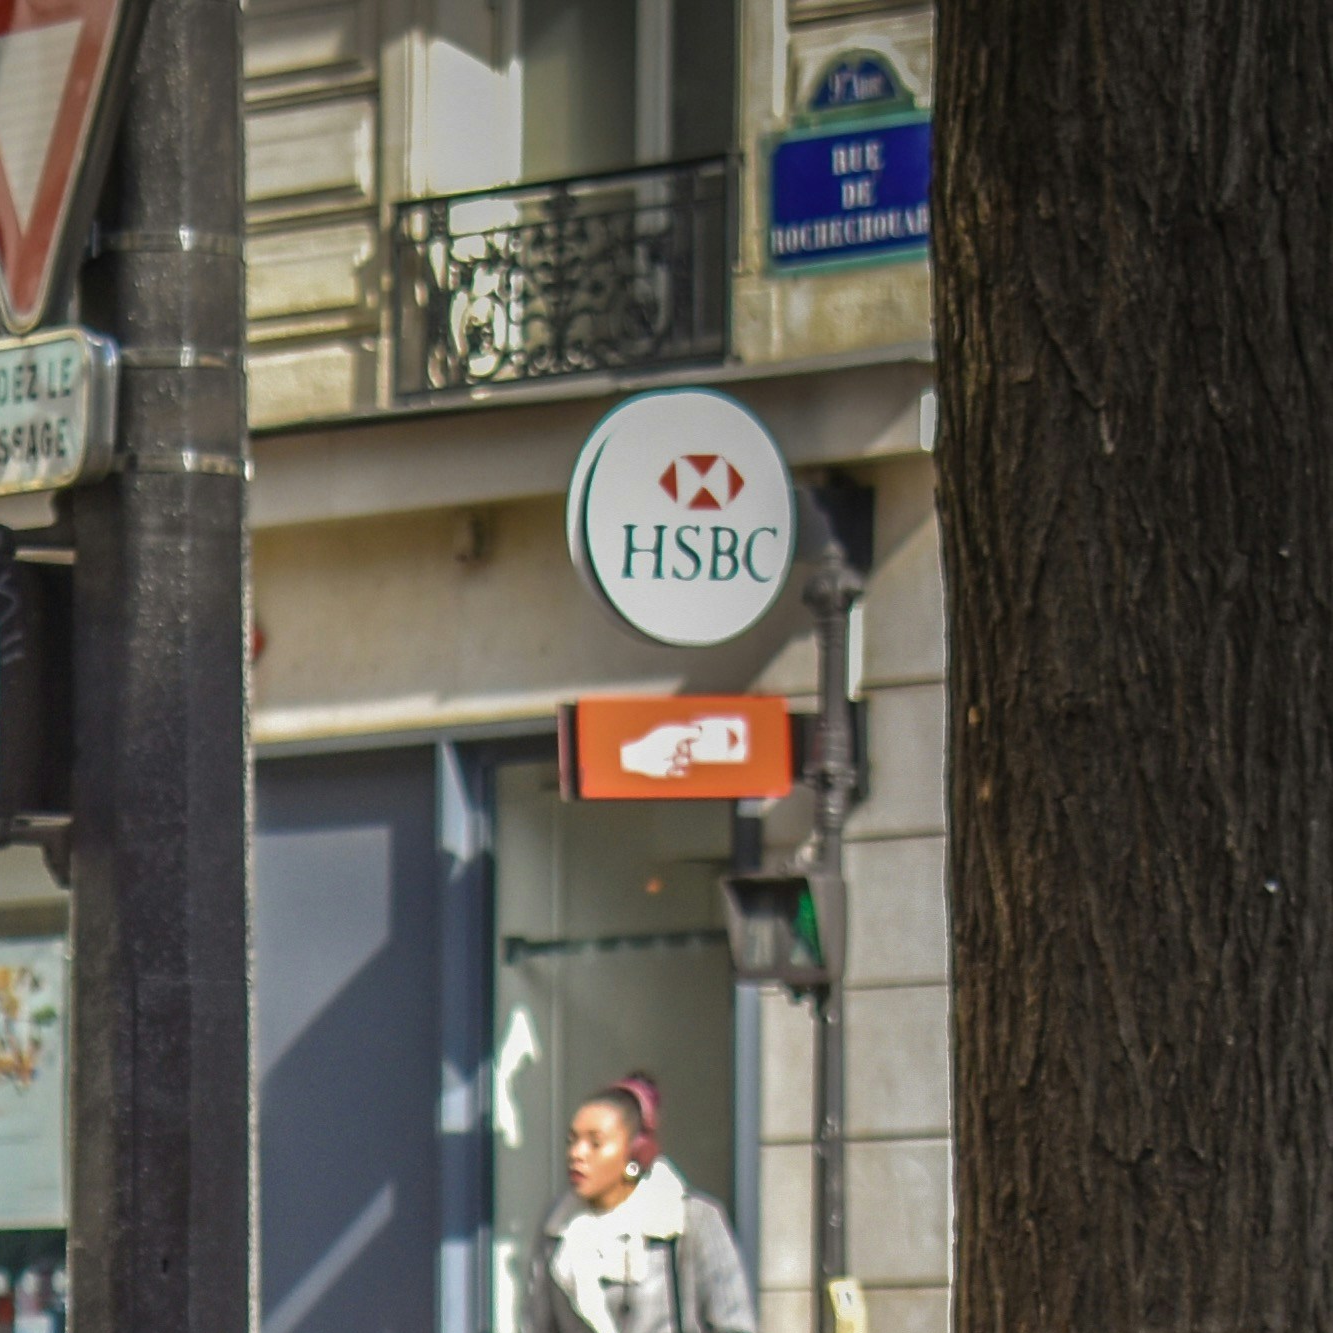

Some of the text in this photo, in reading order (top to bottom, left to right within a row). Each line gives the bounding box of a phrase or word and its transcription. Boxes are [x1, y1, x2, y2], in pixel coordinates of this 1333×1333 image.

[832, 139, 883, 176] RUE
[841, 177, 875, 210] DE
[47, 356, 73, 399] LE
[620, 523, 778, 583] HSBC
